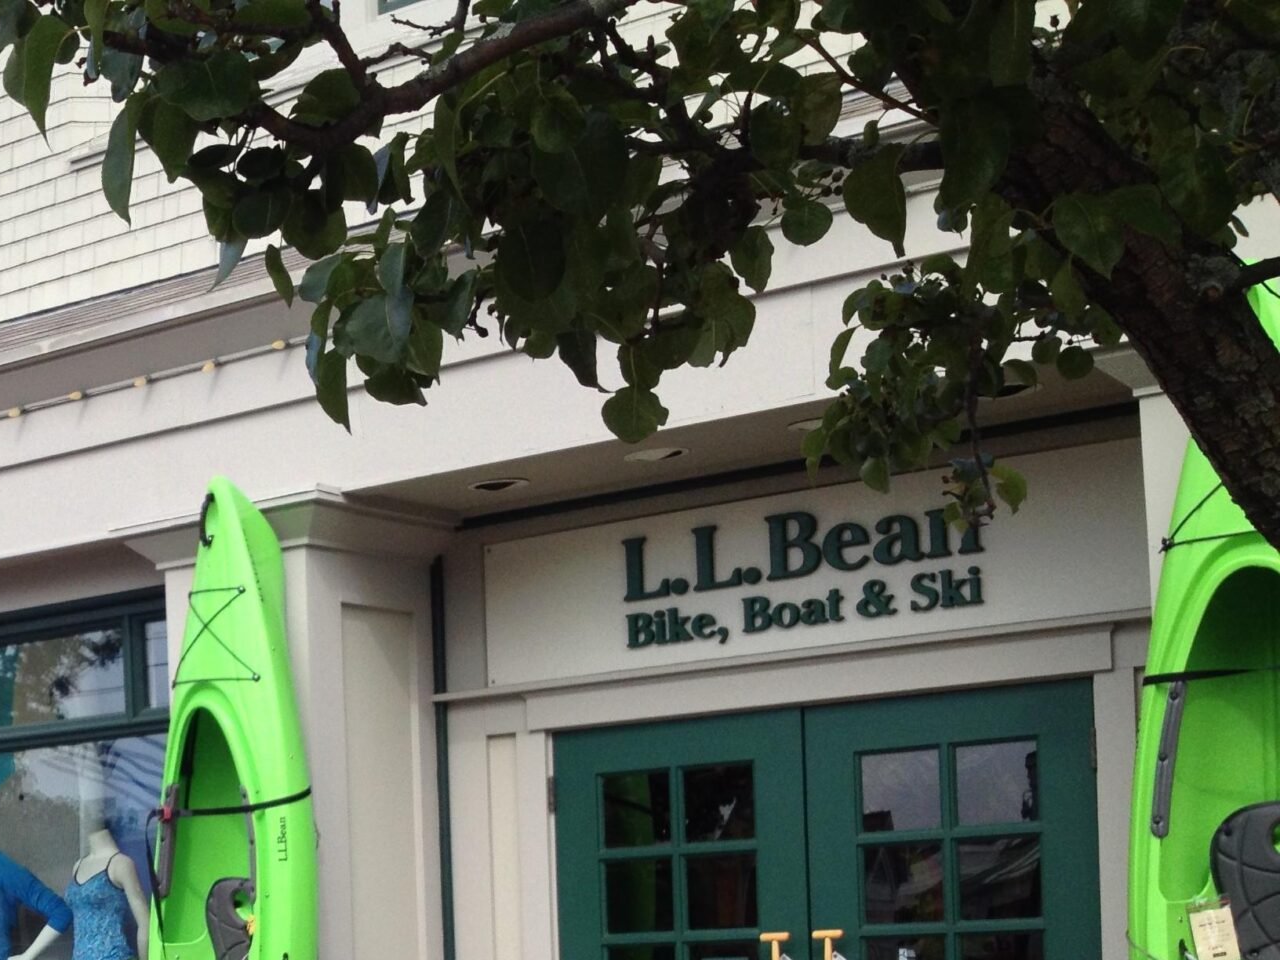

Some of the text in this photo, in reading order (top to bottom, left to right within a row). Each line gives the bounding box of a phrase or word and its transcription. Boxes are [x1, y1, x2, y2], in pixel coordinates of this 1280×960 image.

[622, 509, 985, 601] L.L.Bean
[626, 565, 985, 648] Bike, Boat & Ski
